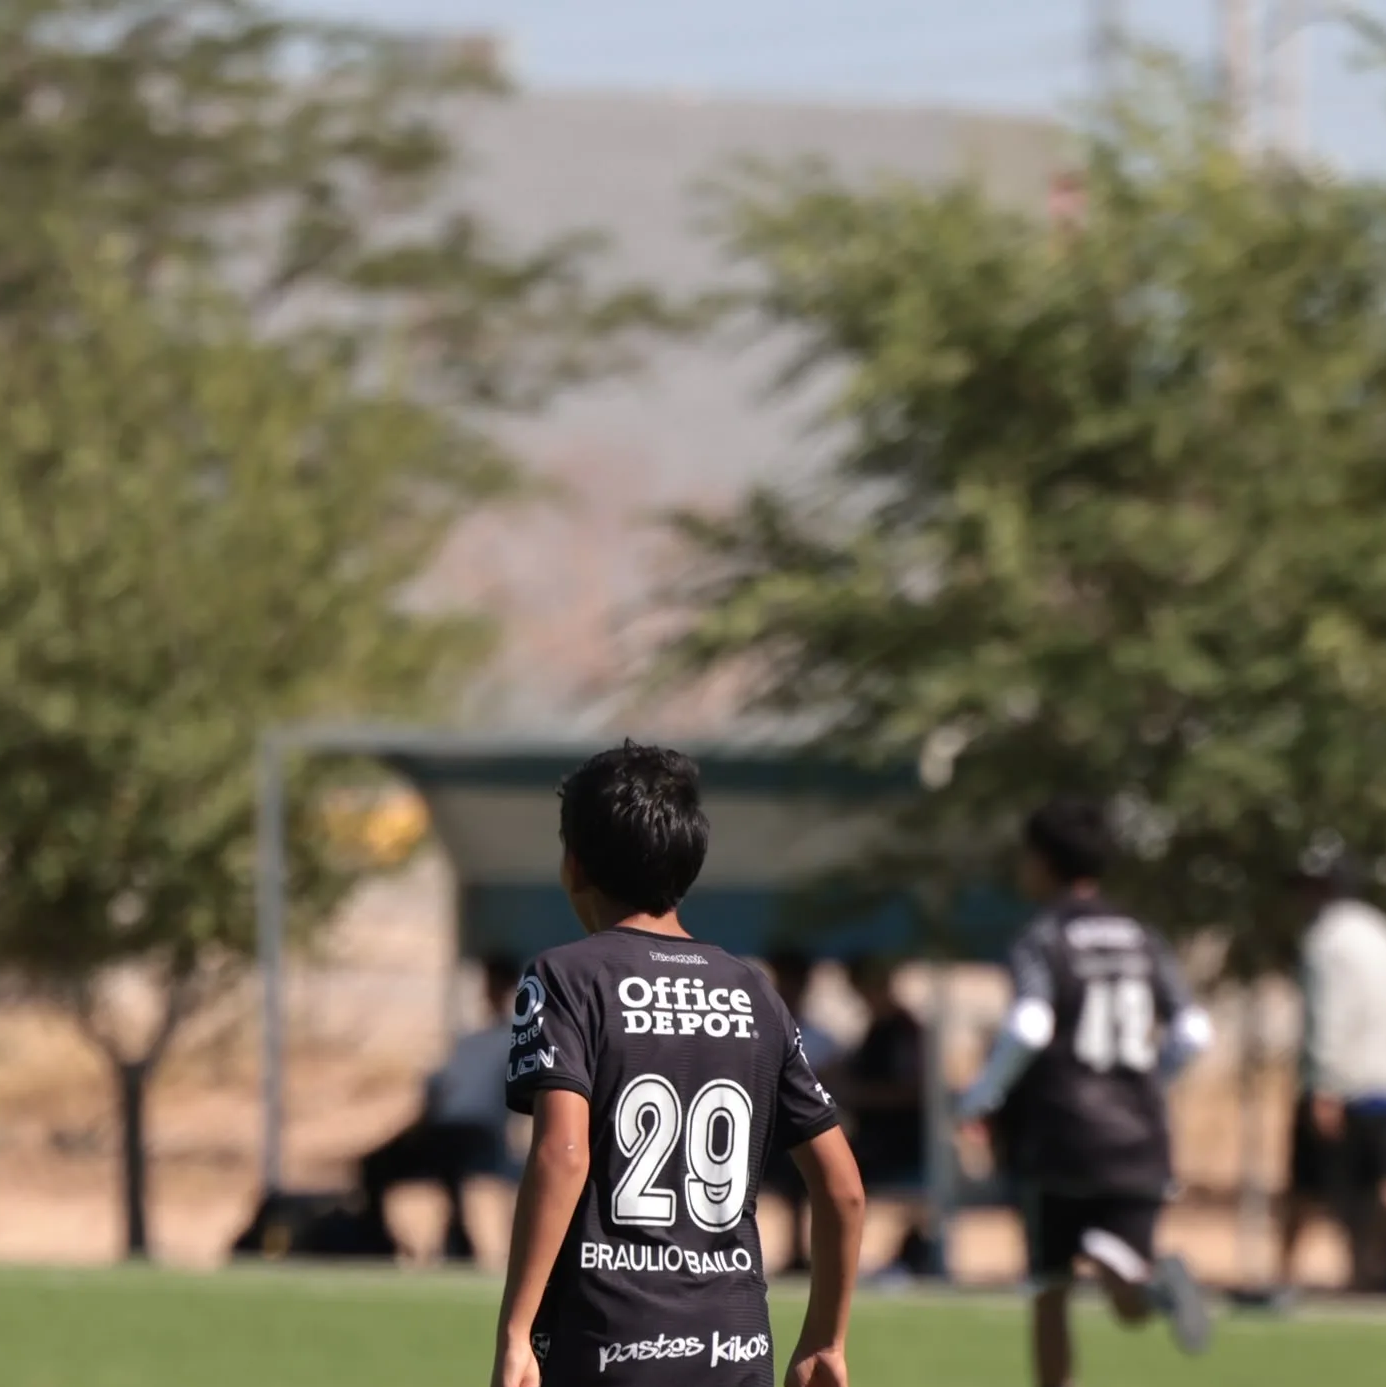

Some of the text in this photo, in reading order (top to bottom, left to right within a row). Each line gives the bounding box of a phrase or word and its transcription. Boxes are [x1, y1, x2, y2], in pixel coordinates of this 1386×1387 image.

[618, 976, 752, 1014] Office
[622, 1010, 754, 1038] DEPOT
[612, 1073, 753, 1233] 29
[580, 1242, 683, 1272] BRAULIO
[599, 1333, 705, 1373] pastes
